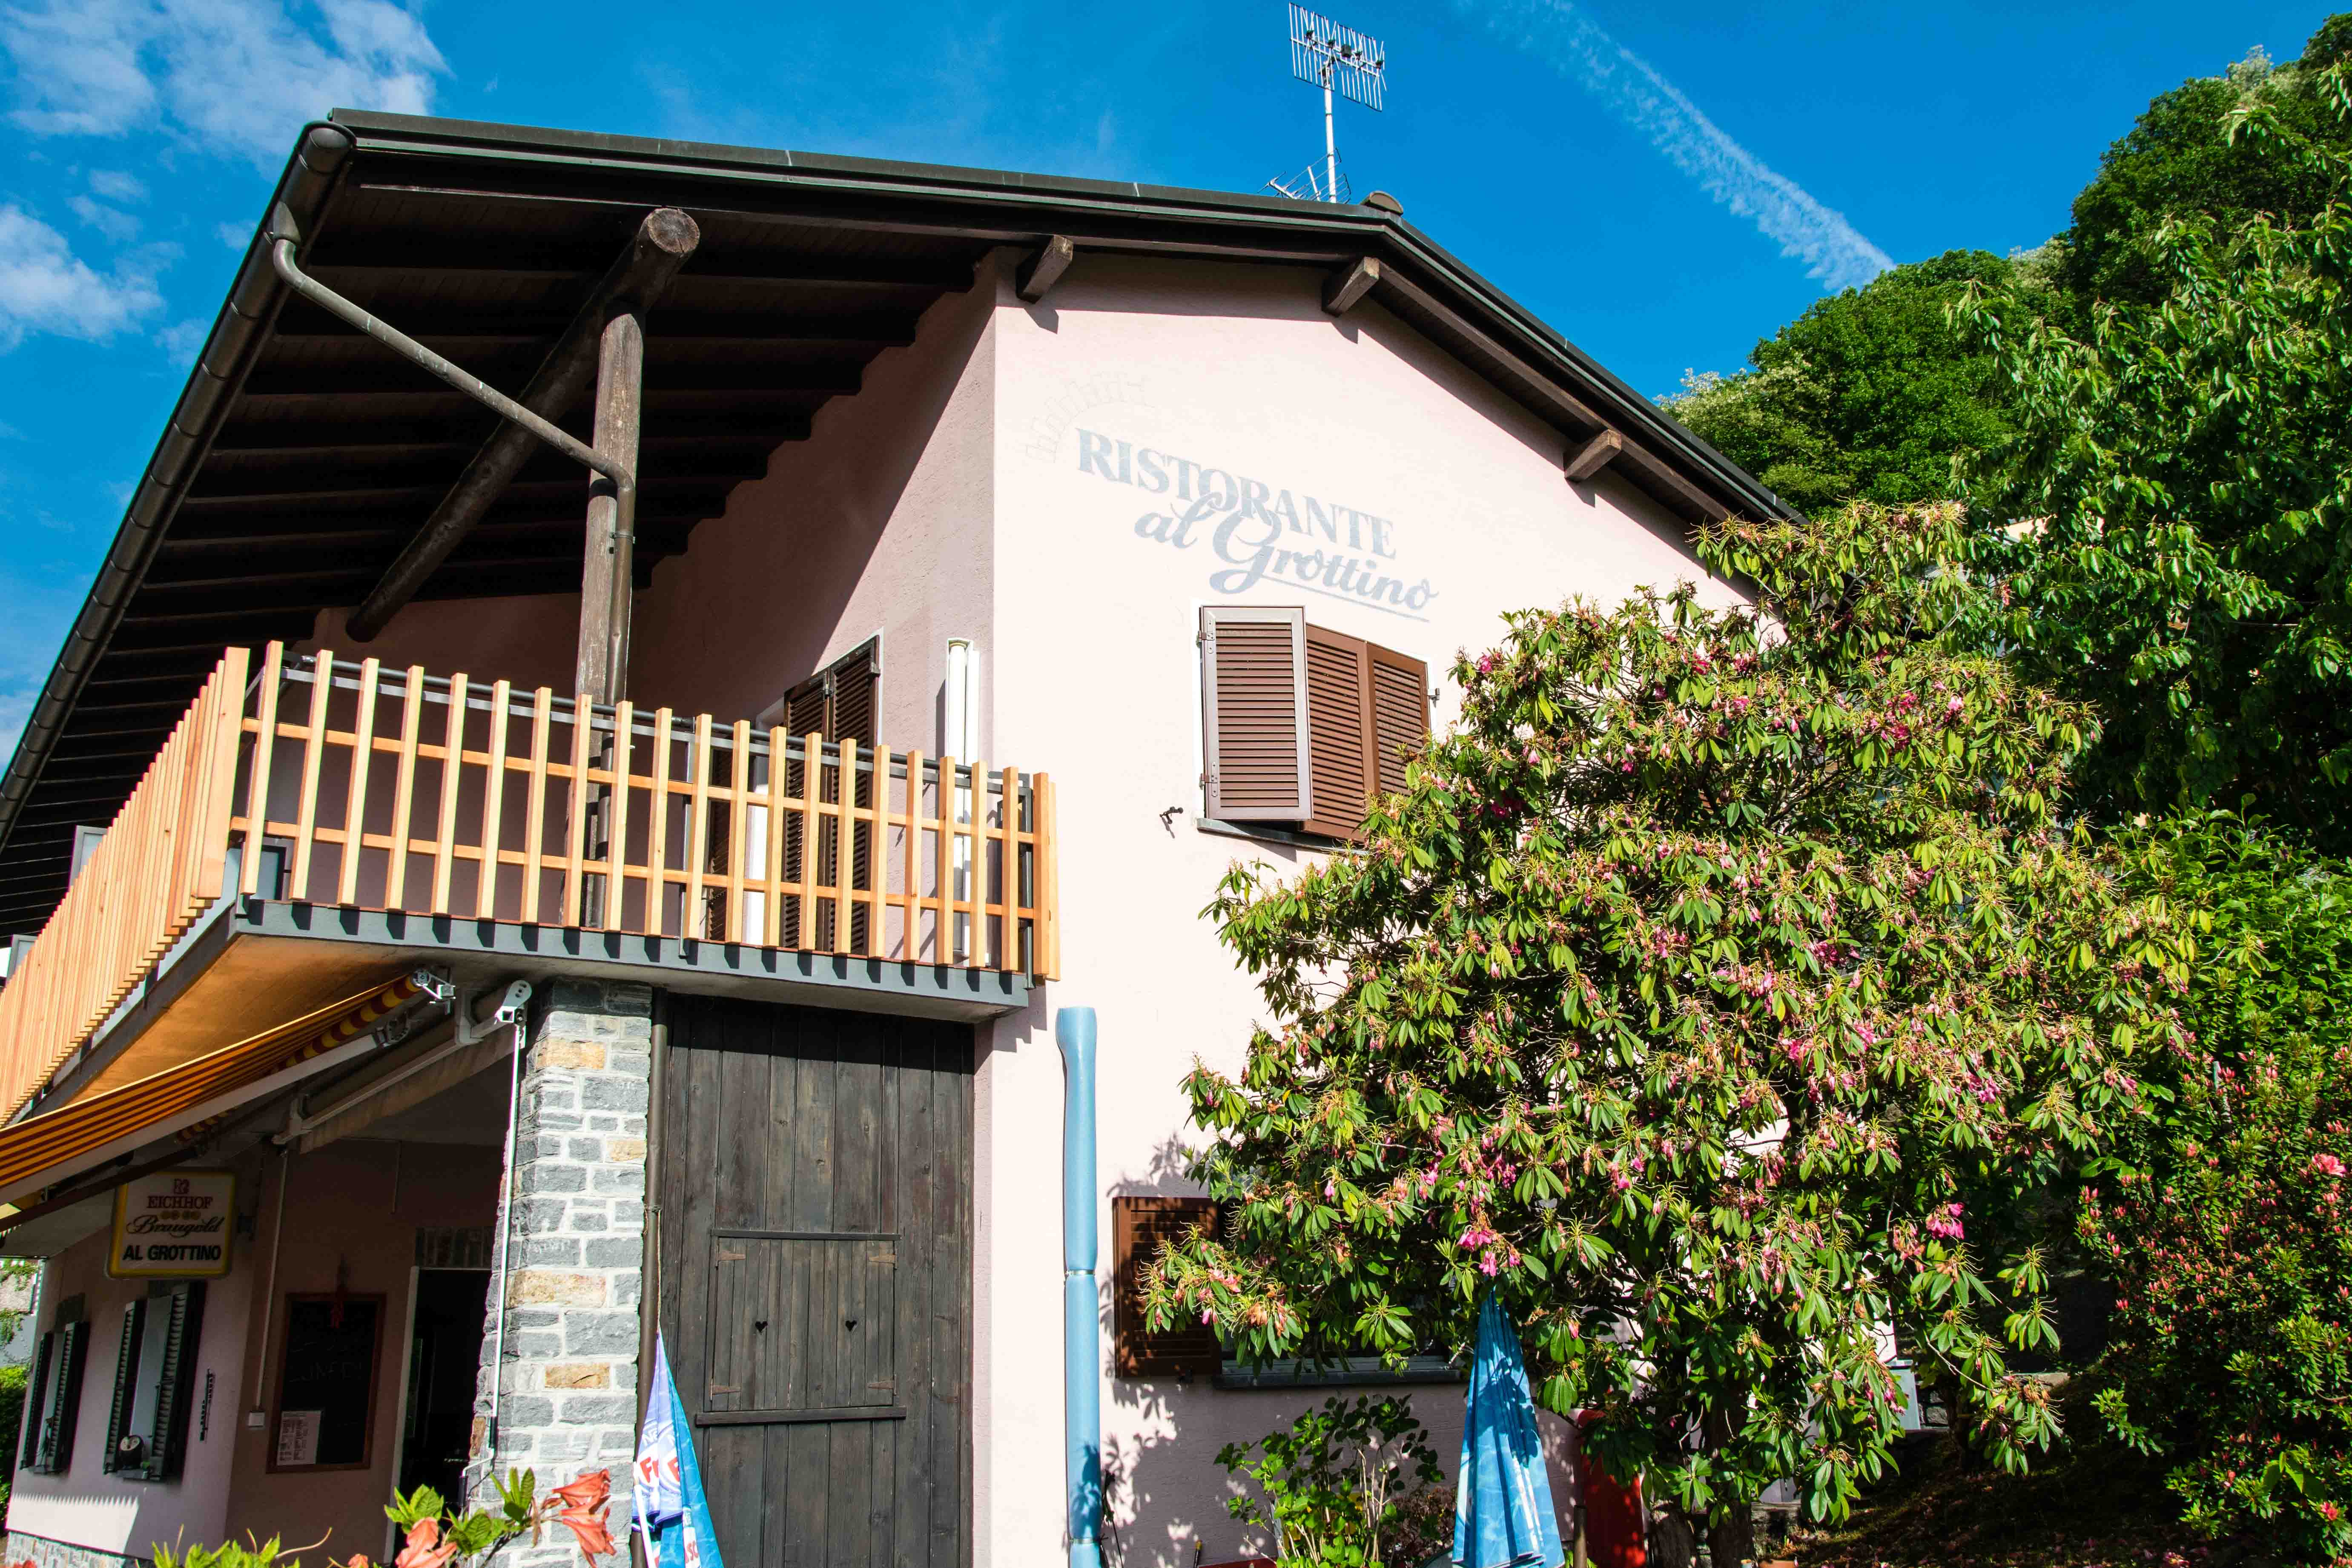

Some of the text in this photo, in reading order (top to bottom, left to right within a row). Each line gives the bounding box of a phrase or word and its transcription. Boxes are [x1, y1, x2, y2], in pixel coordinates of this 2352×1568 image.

[1075, 427, 1397, 560] RISTORANTE
[1133, 491, 1440, 611] al Grottino
[146, 1195, 213, 1209] EICHHOF
[126, 1214, 226, 1238] Braugold
[123, 1244, 222, 1261] AL GROTTINO
